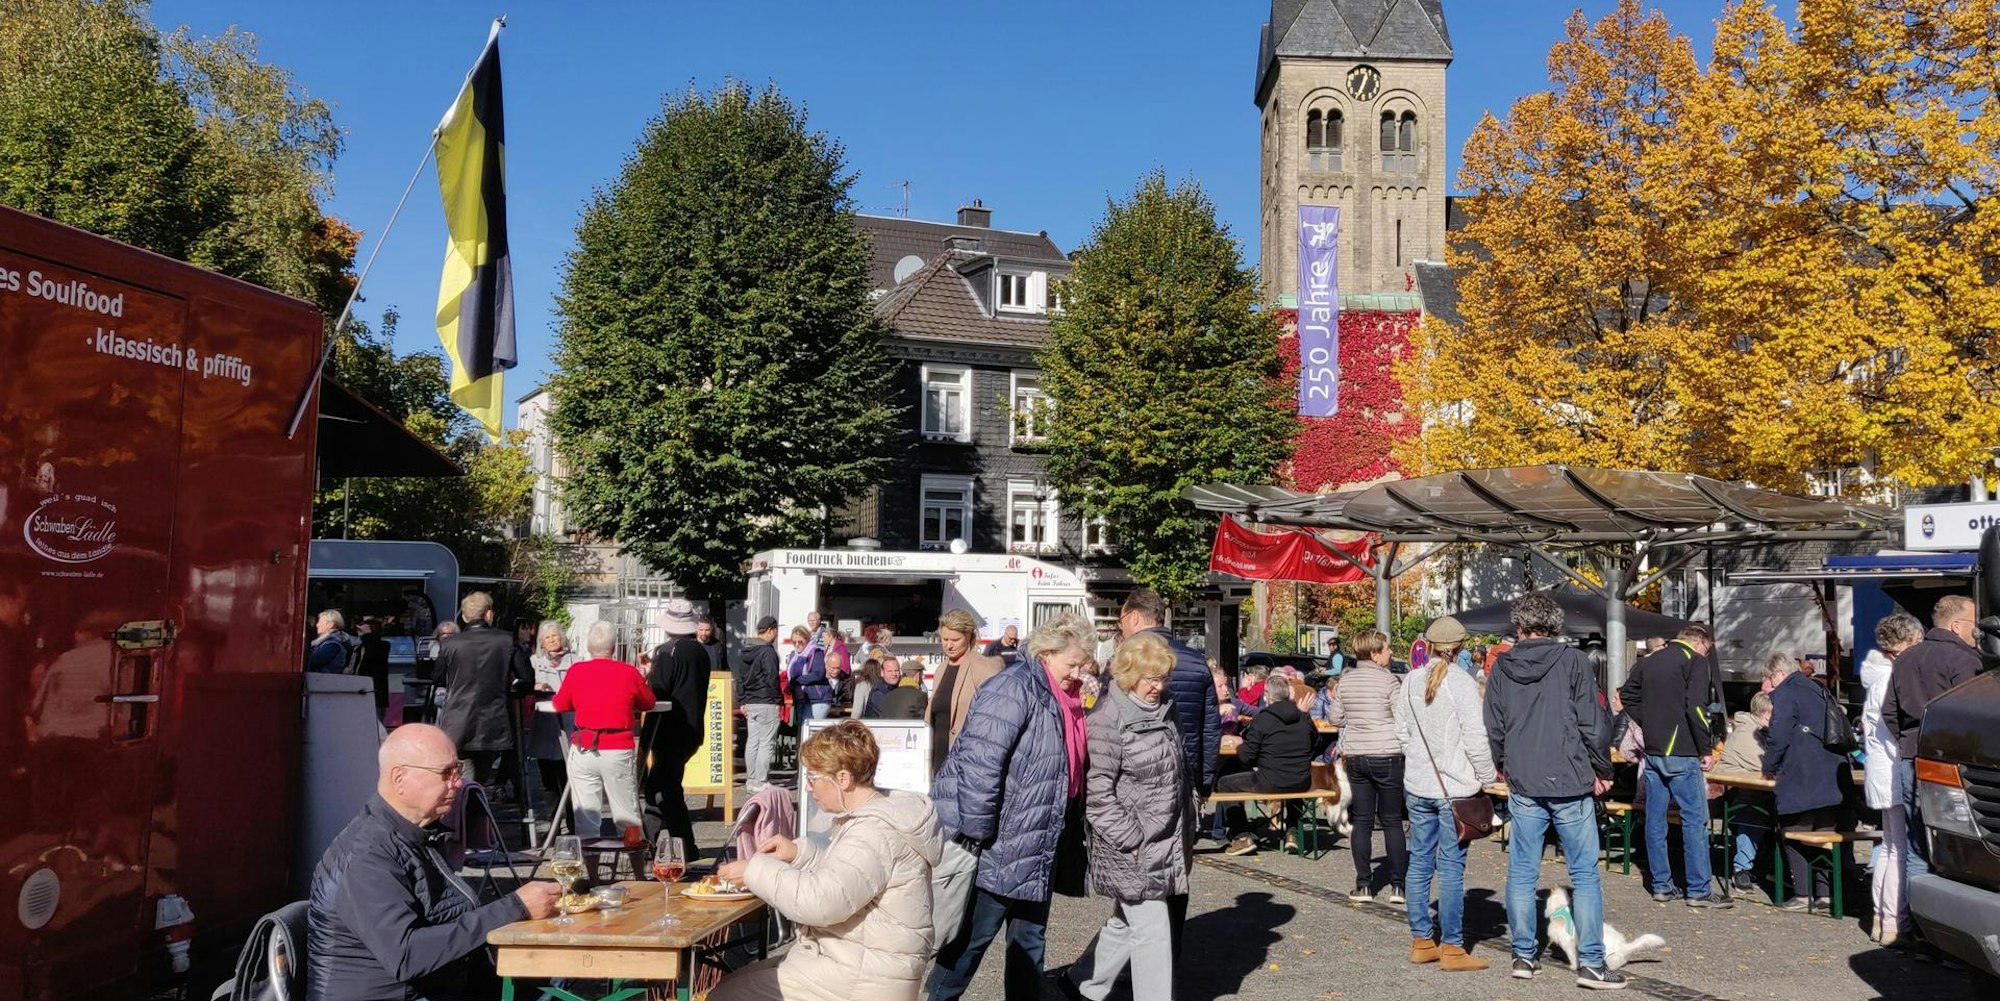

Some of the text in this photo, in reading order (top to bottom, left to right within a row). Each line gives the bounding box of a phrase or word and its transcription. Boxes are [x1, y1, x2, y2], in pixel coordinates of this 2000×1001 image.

[27, 270, 124, 318] Soulfood
[1304, 260, 1335, 400] 250 Jahre
[95, 327, 252, 386] klassisch & pfiffig
[34, 515, 75, 535] Schwaben
[785, 551, 888, 567] Foodtruck buchen
